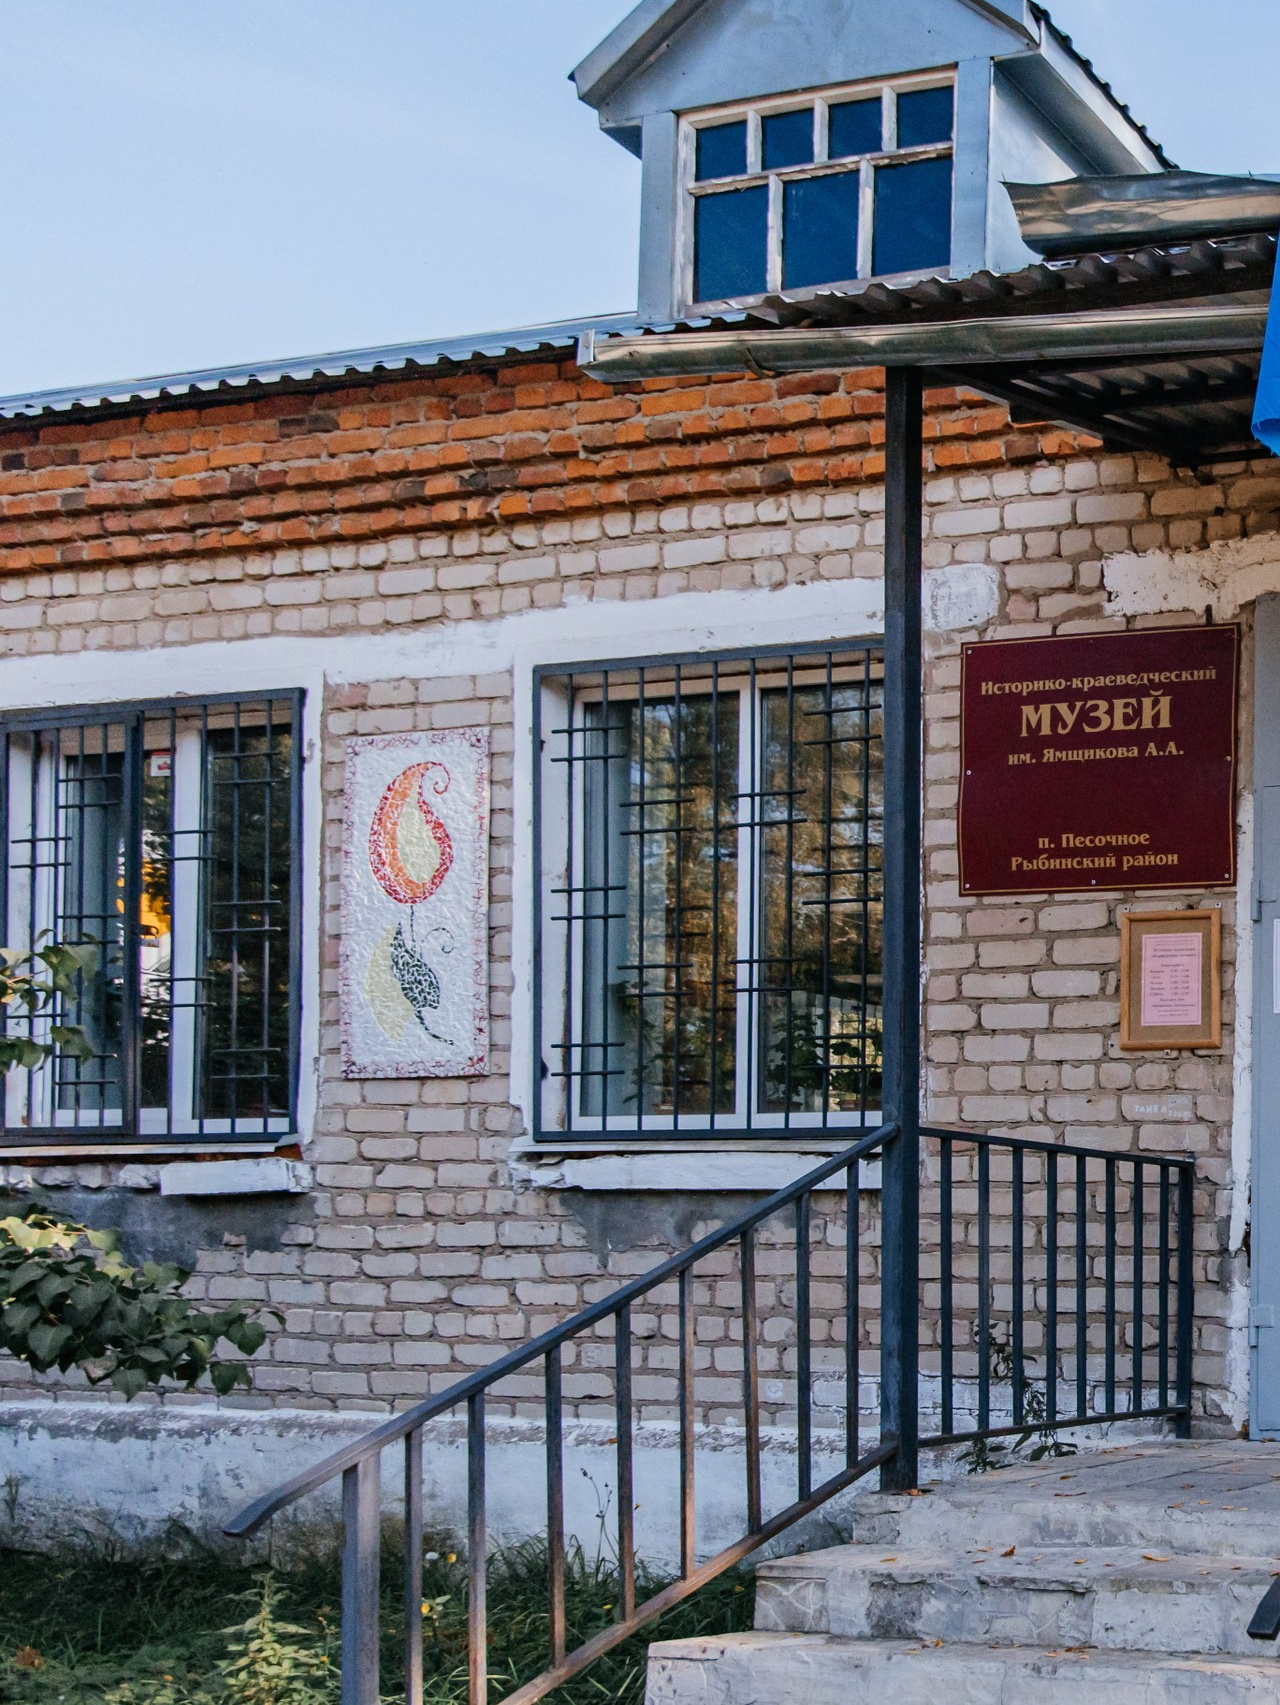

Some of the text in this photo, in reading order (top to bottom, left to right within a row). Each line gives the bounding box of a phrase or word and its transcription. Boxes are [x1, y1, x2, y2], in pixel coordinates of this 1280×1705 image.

[980, 665, 1217, 696] Историко-краеведческий
[1018, 688, 1173, 738] МУЗЕЙ
[1007, 740, 1185, 766] им. Ямщикова А.А.
[1037, 832, 1151, 850] п. Песочное
[1010, 850, 1180, 872] Рыбинский район
